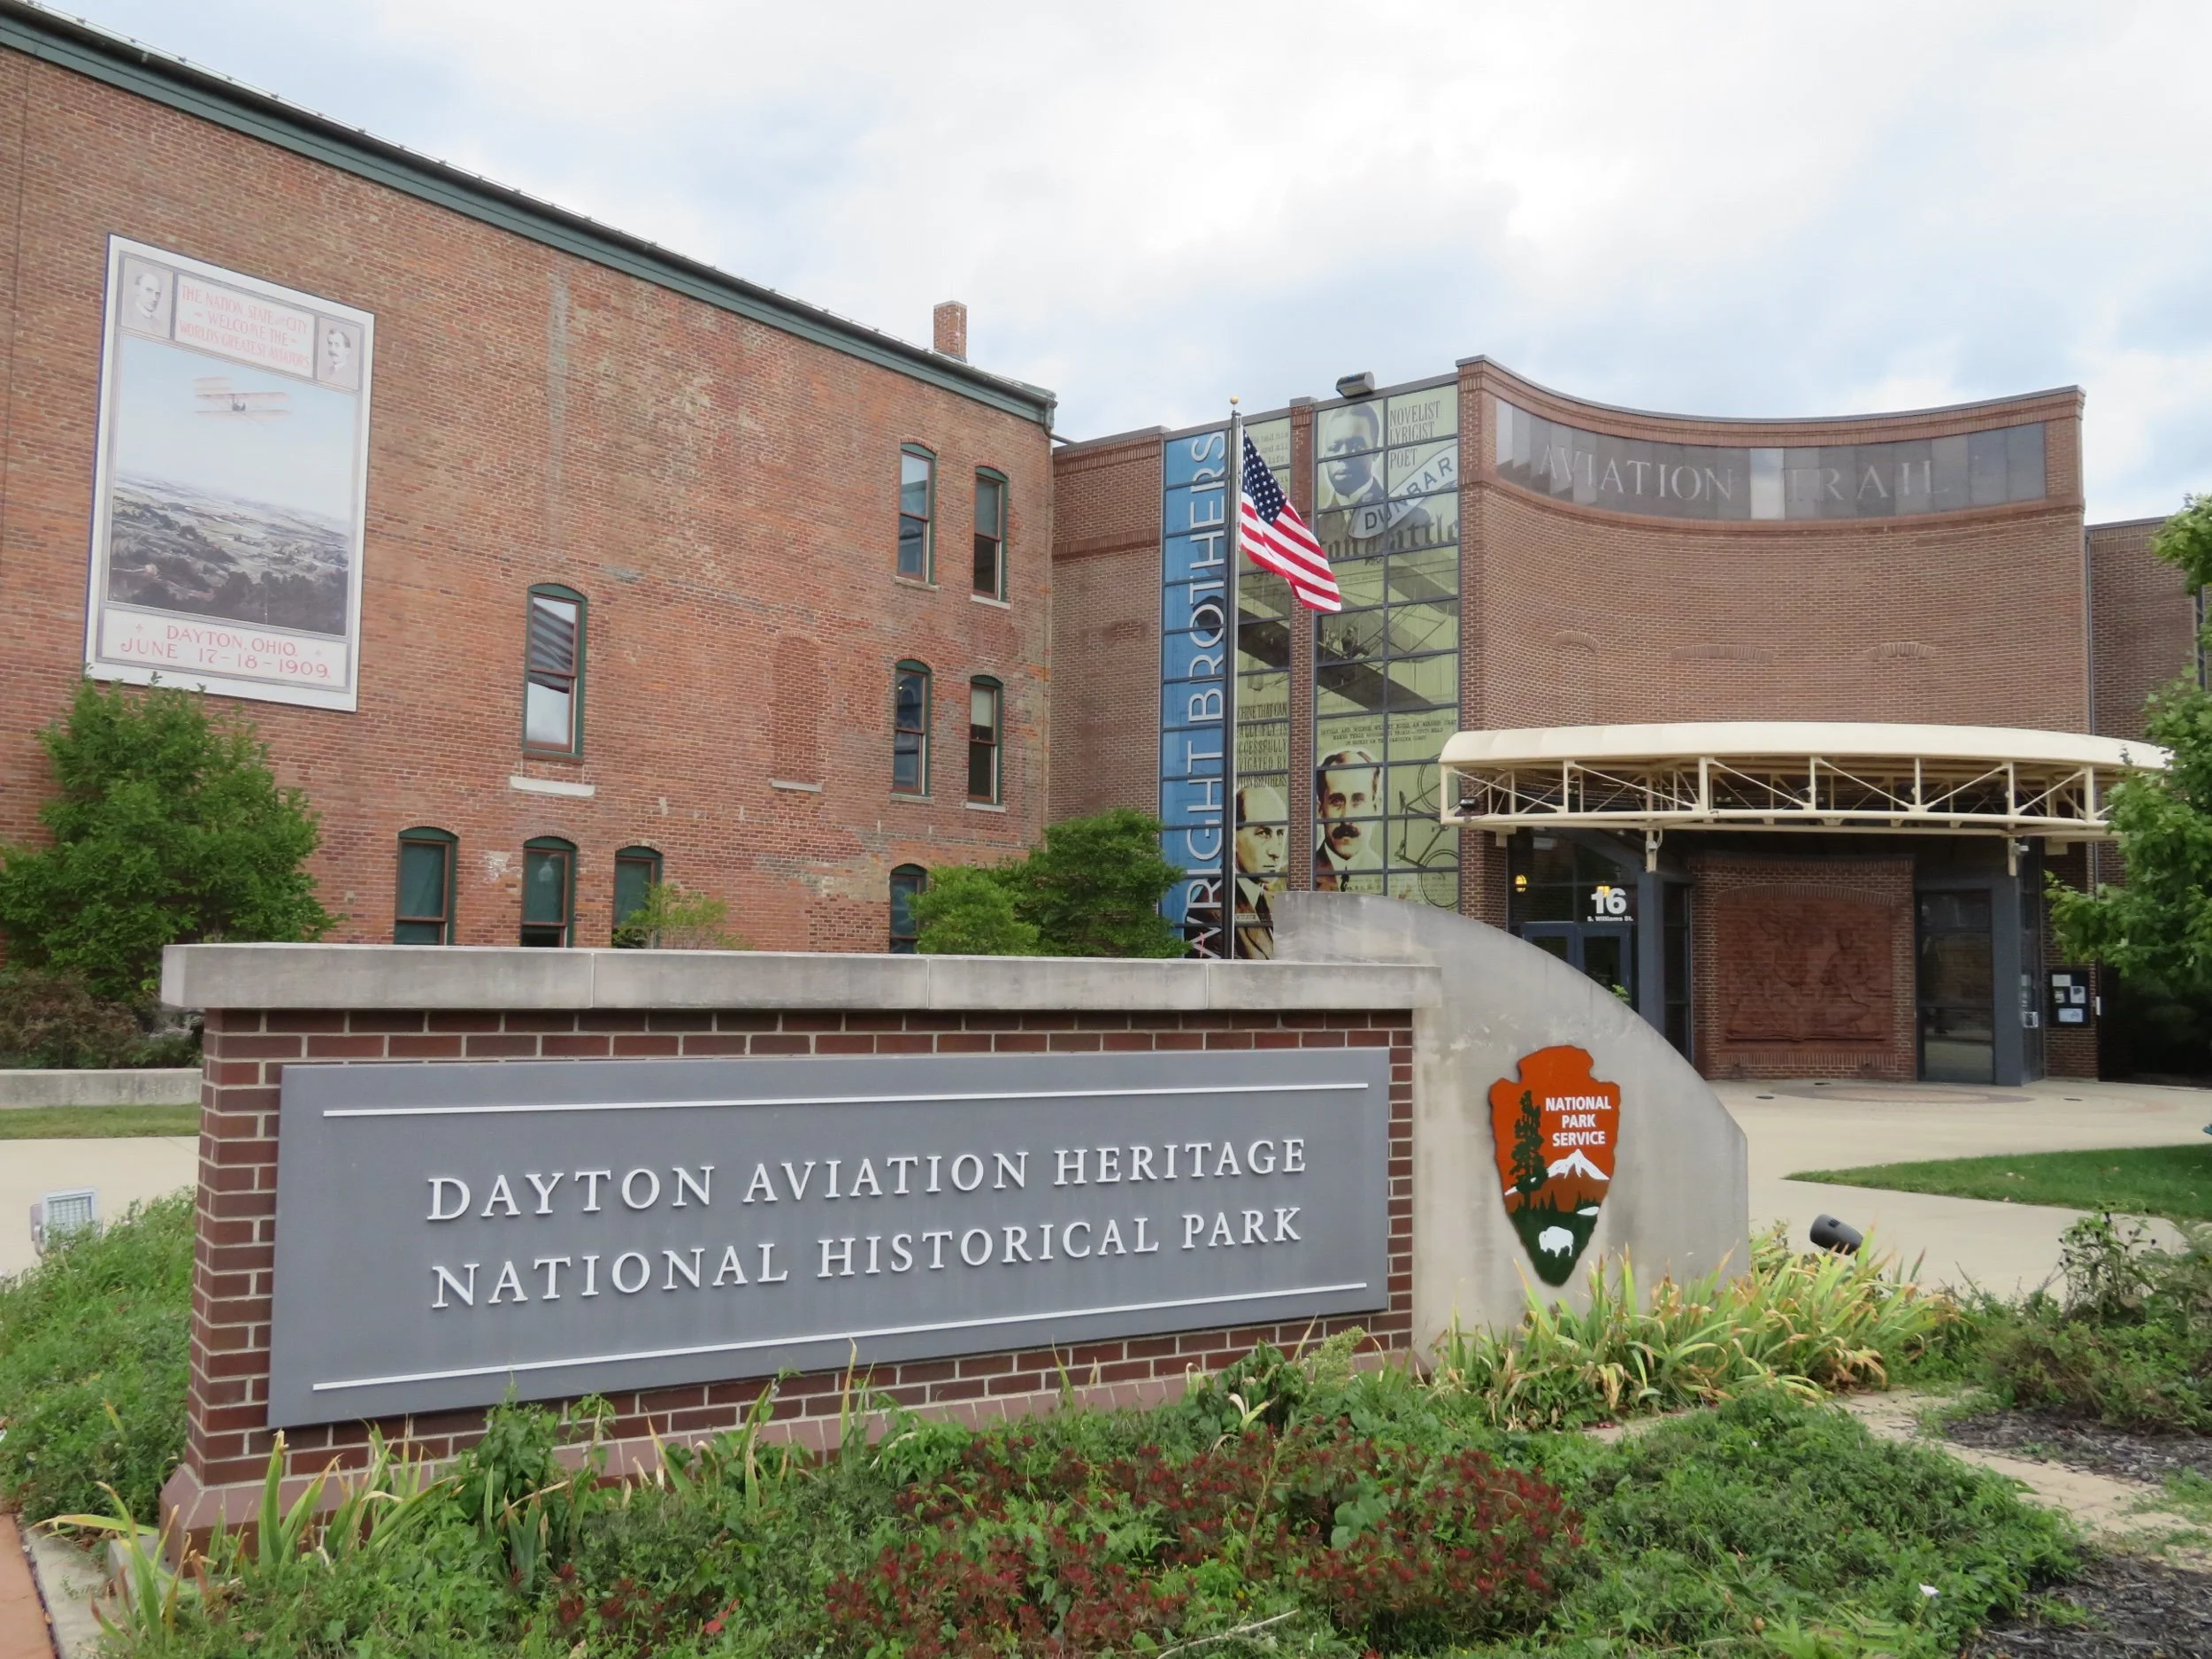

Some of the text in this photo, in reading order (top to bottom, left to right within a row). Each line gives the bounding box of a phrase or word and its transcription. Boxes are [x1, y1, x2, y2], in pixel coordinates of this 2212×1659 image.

[182, 285, 203, 303] THE
[205, 292, 243, 315] NATION
[248, 304, 274, 325] STATE
[286, 317, 309, 334] CITY
[208, 311, 266, 340] WELCOME
[270, 328, 288, 347] THE
[1389, 400, 1440, 427] NOVELIST
[1388, 420, 1435, 446] LYRICIST
[1390, 448, 1417, 470] POET
[1540, 444, 1733, 502] AVIATION
[1783, 459, 1949, 503] TRAIL
[1188, 431, 1225, 722] BROTHERS
[120, 637, 179, 658] JUNE
[1591, 887, 1627, 915] 16
[1545, 1095, 1612, 1112] NATIONAL
[1561, 1114, 1596, 1129] PARK
[1552, 1131, 1606, 1148] SERVICE
[426, 1138, 1307, 1221] DAYTON AVIATION HERITAGE
[432, 1206, 1302, 1310] NATIONAL HISTORICAL PARK
